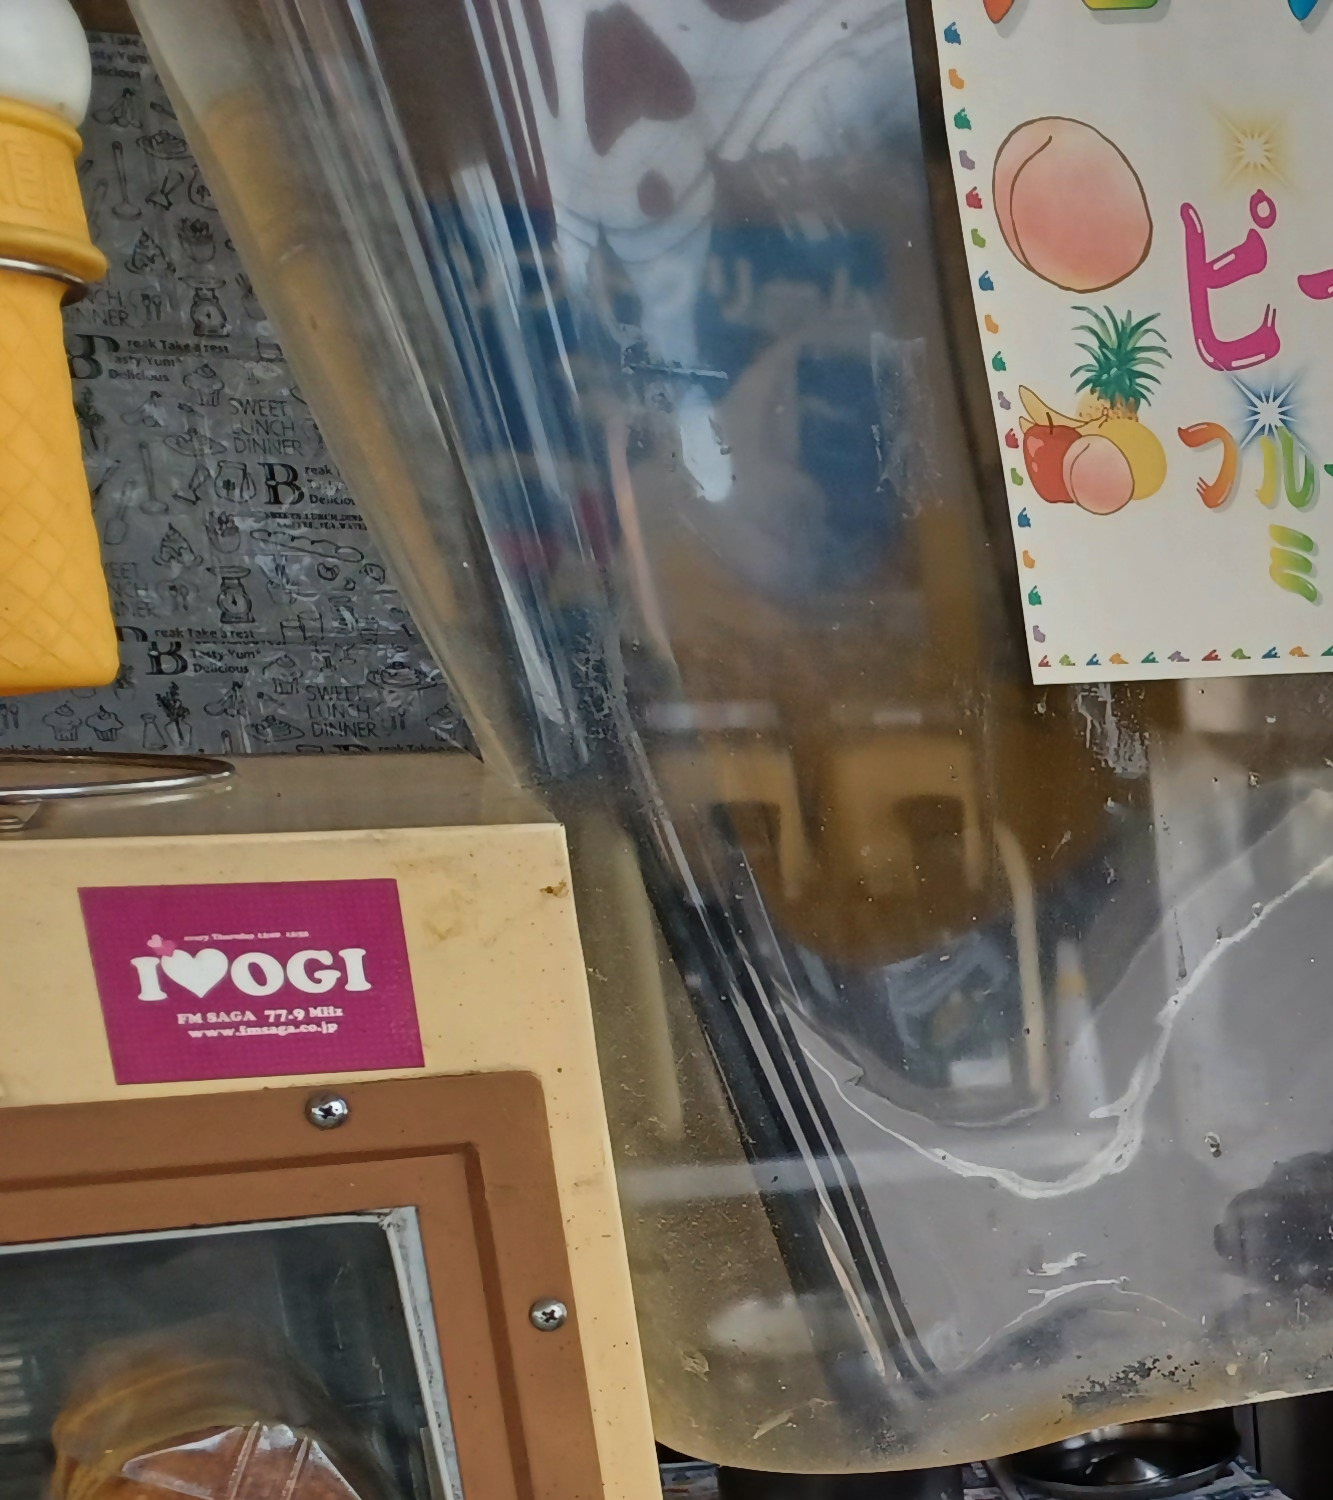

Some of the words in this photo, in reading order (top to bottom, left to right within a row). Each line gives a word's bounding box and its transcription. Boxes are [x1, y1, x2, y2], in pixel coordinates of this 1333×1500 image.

[311, 721, 380, 738] DINNER
[231, 948, 372, 997] OGI
[177, 1013, 203, 1024] FM
[206, 1010, 257, 1023] SAGA
[264, 1008, 306, 1022] 77.9
[309, 1006, 344, 1018] MHz
[188, 1021, 339, 1038] www.fmsaga.co.jp
